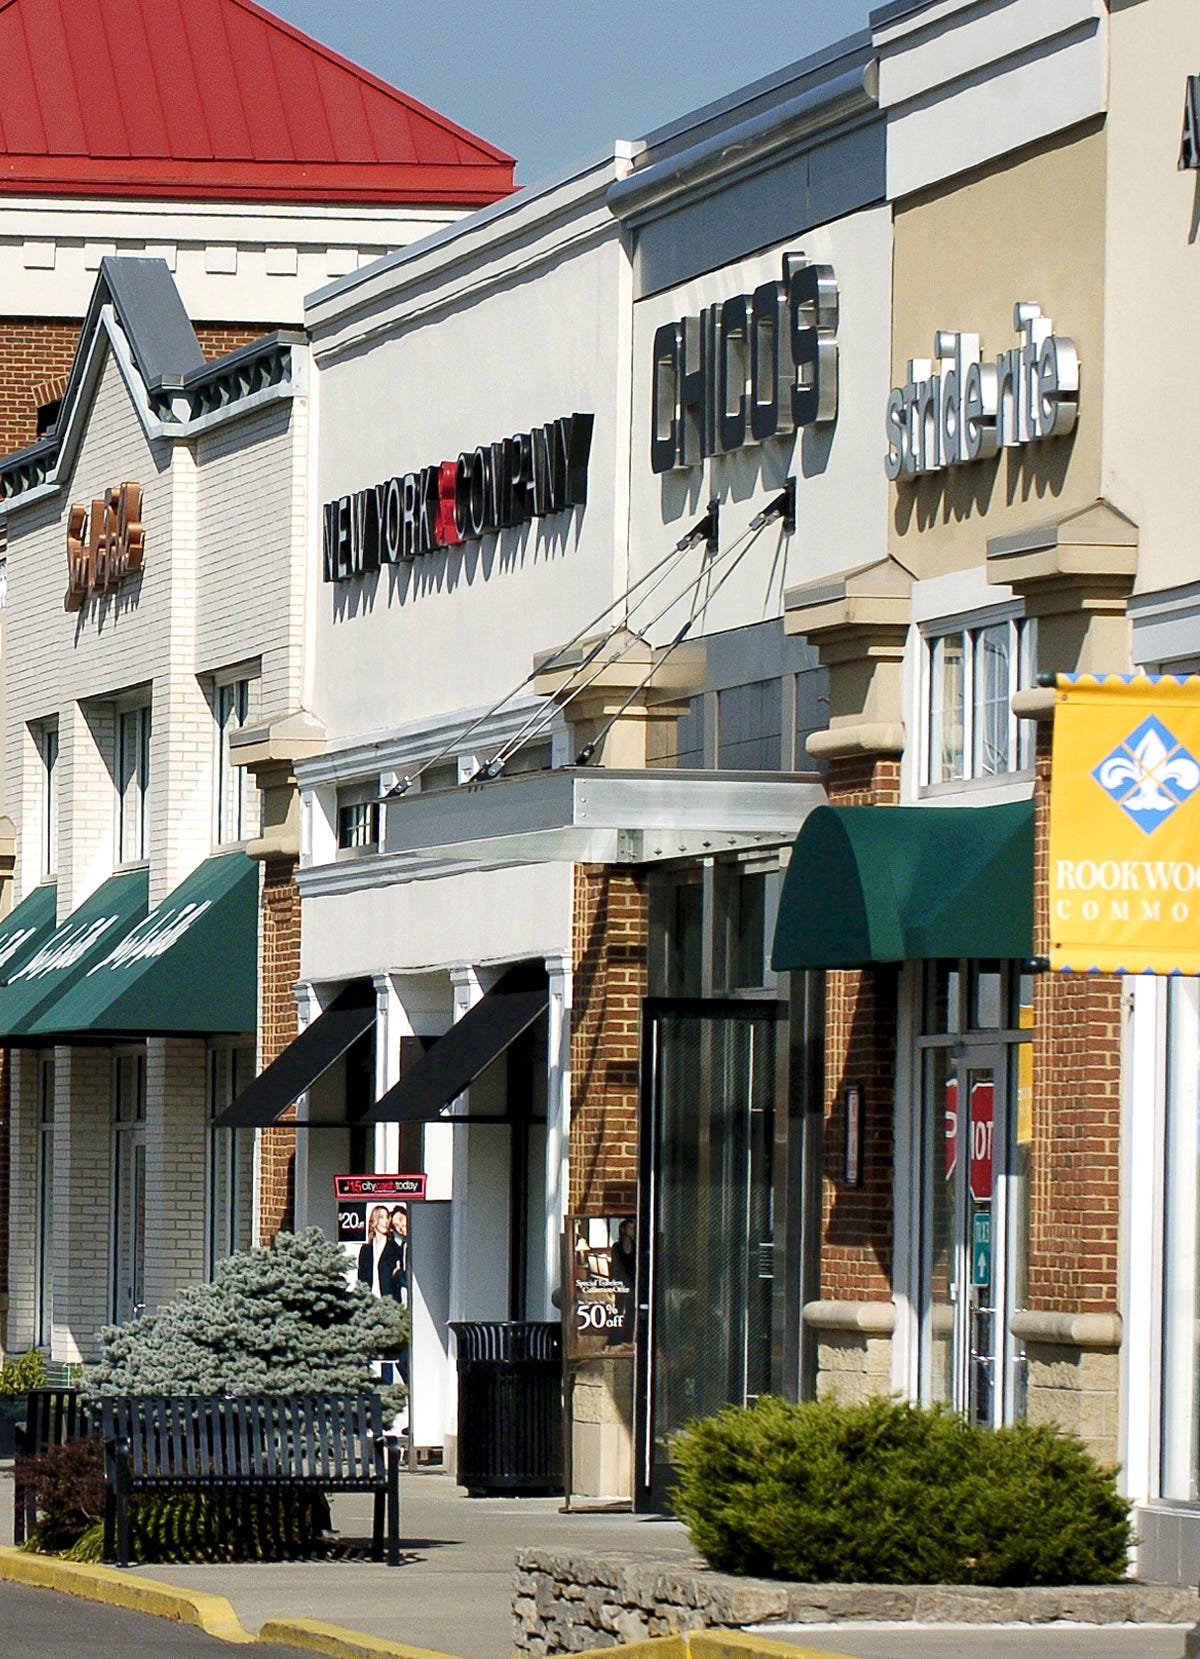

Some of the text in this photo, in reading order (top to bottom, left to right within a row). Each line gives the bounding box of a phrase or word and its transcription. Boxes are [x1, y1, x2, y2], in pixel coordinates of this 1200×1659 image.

[322, 489, 380, 582] NEW
[375, 465, 441, 564] YORK
[606, 1315, 625, 1328] off
